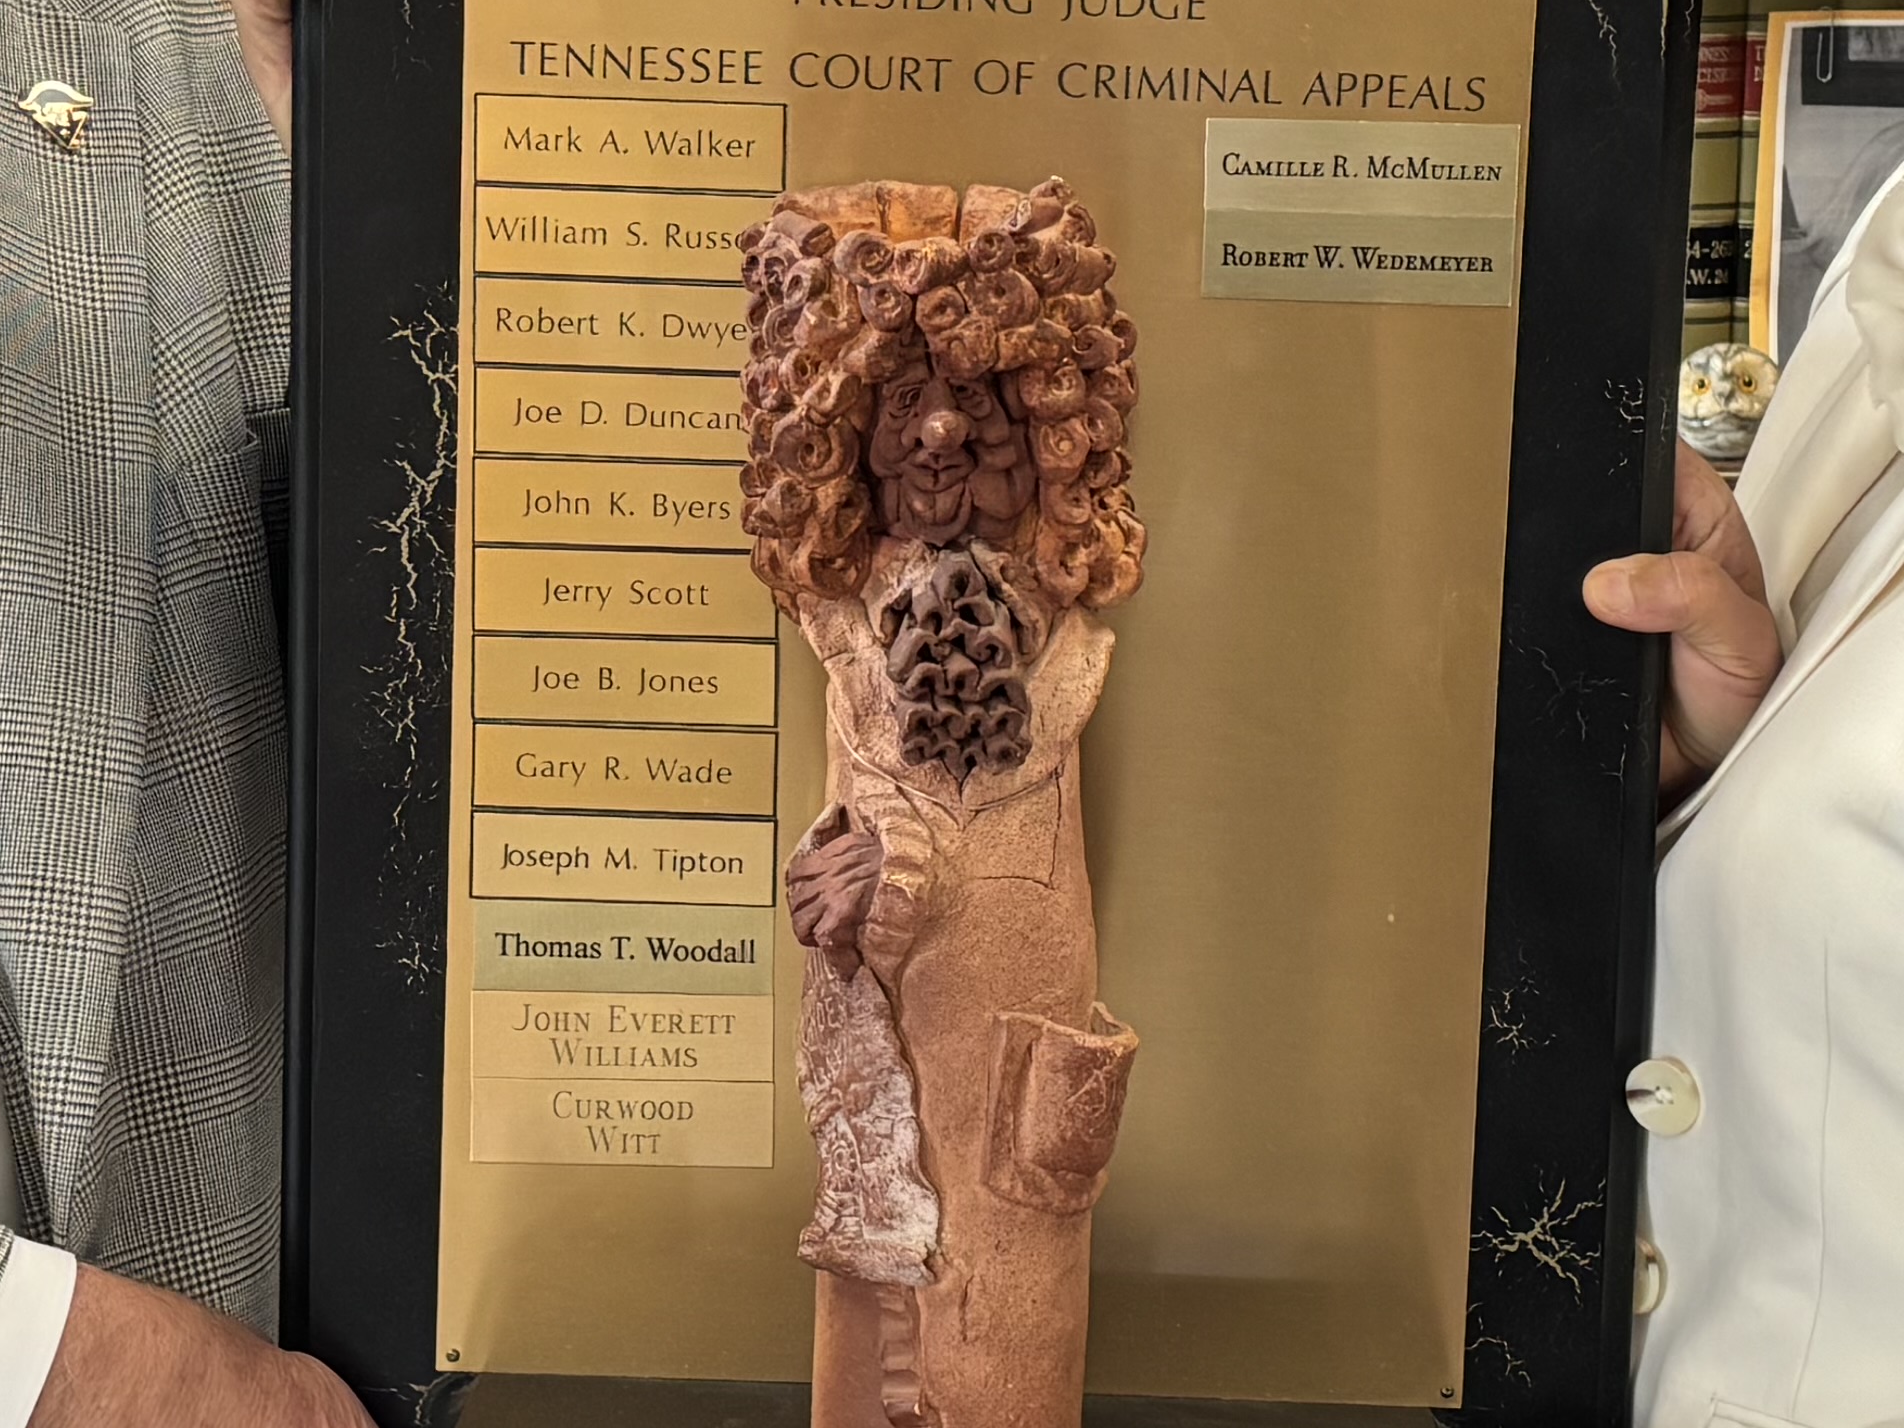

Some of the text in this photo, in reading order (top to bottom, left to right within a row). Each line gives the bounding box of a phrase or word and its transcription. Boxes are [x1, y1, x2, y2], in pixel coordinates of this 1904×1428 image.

[511, 40, 1487, 112] TENNESSEE COURT OF CRIMINAL APPEALS
[503, 125, 757, 159] Mark A. Walker
[1222, 152, 1325, 180] CAMILLE
[1333, 155, 1359, 180] R.
[485, 216, 608, 247] William
[626, 222, 648, 248] S.
[1222, 243, 1494, 273] ROBERT W. WEDEMEYER
[496, 307, 749, 345] Robert K. Dwye
[514, 397, 742, 433] Joe D. Duncan
[522, 488, 731, 525] John K. Byers
[543, 577, 710, 612] Jerry Scott
[533, 665, 719, 698] Joe B. Jones
[516, 752, 733, 786] Gary R. Wade
[501, 843, 744, 879] Joseph M. Tipton
[495, 931, 757, 965] Thomas T. Woodall
[512, 1003, 736, 1035] JOHN EVERETT
[549, 1038, 698, 1069] WILLIAMS
[552, 1091, 694, 1122] CURWOOD
[586, 1123, 661, 1156] WITT
